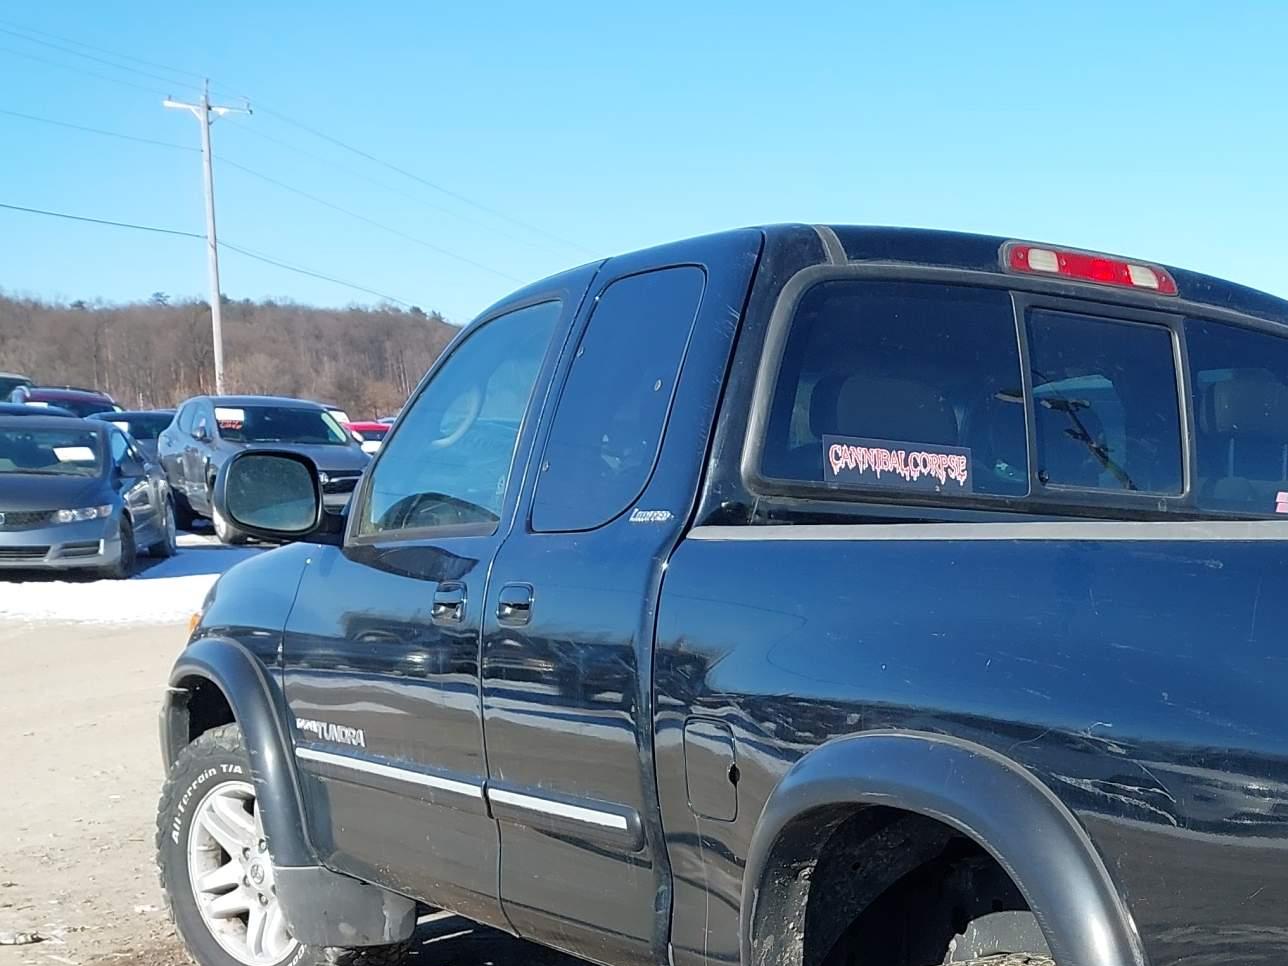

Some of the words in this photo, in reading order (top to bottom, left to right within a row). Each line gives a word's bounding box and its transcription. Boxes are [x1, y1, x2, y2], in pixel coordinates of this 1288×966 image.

[829, 444, 909, 481] CANNIBAL
[907, 451, 967, 486] CORPSE
[318, 722, 366, 748] TUNDRA
[171, 768, 217, 845] All-Terrain
[220, 764, 243, 774] T/A
